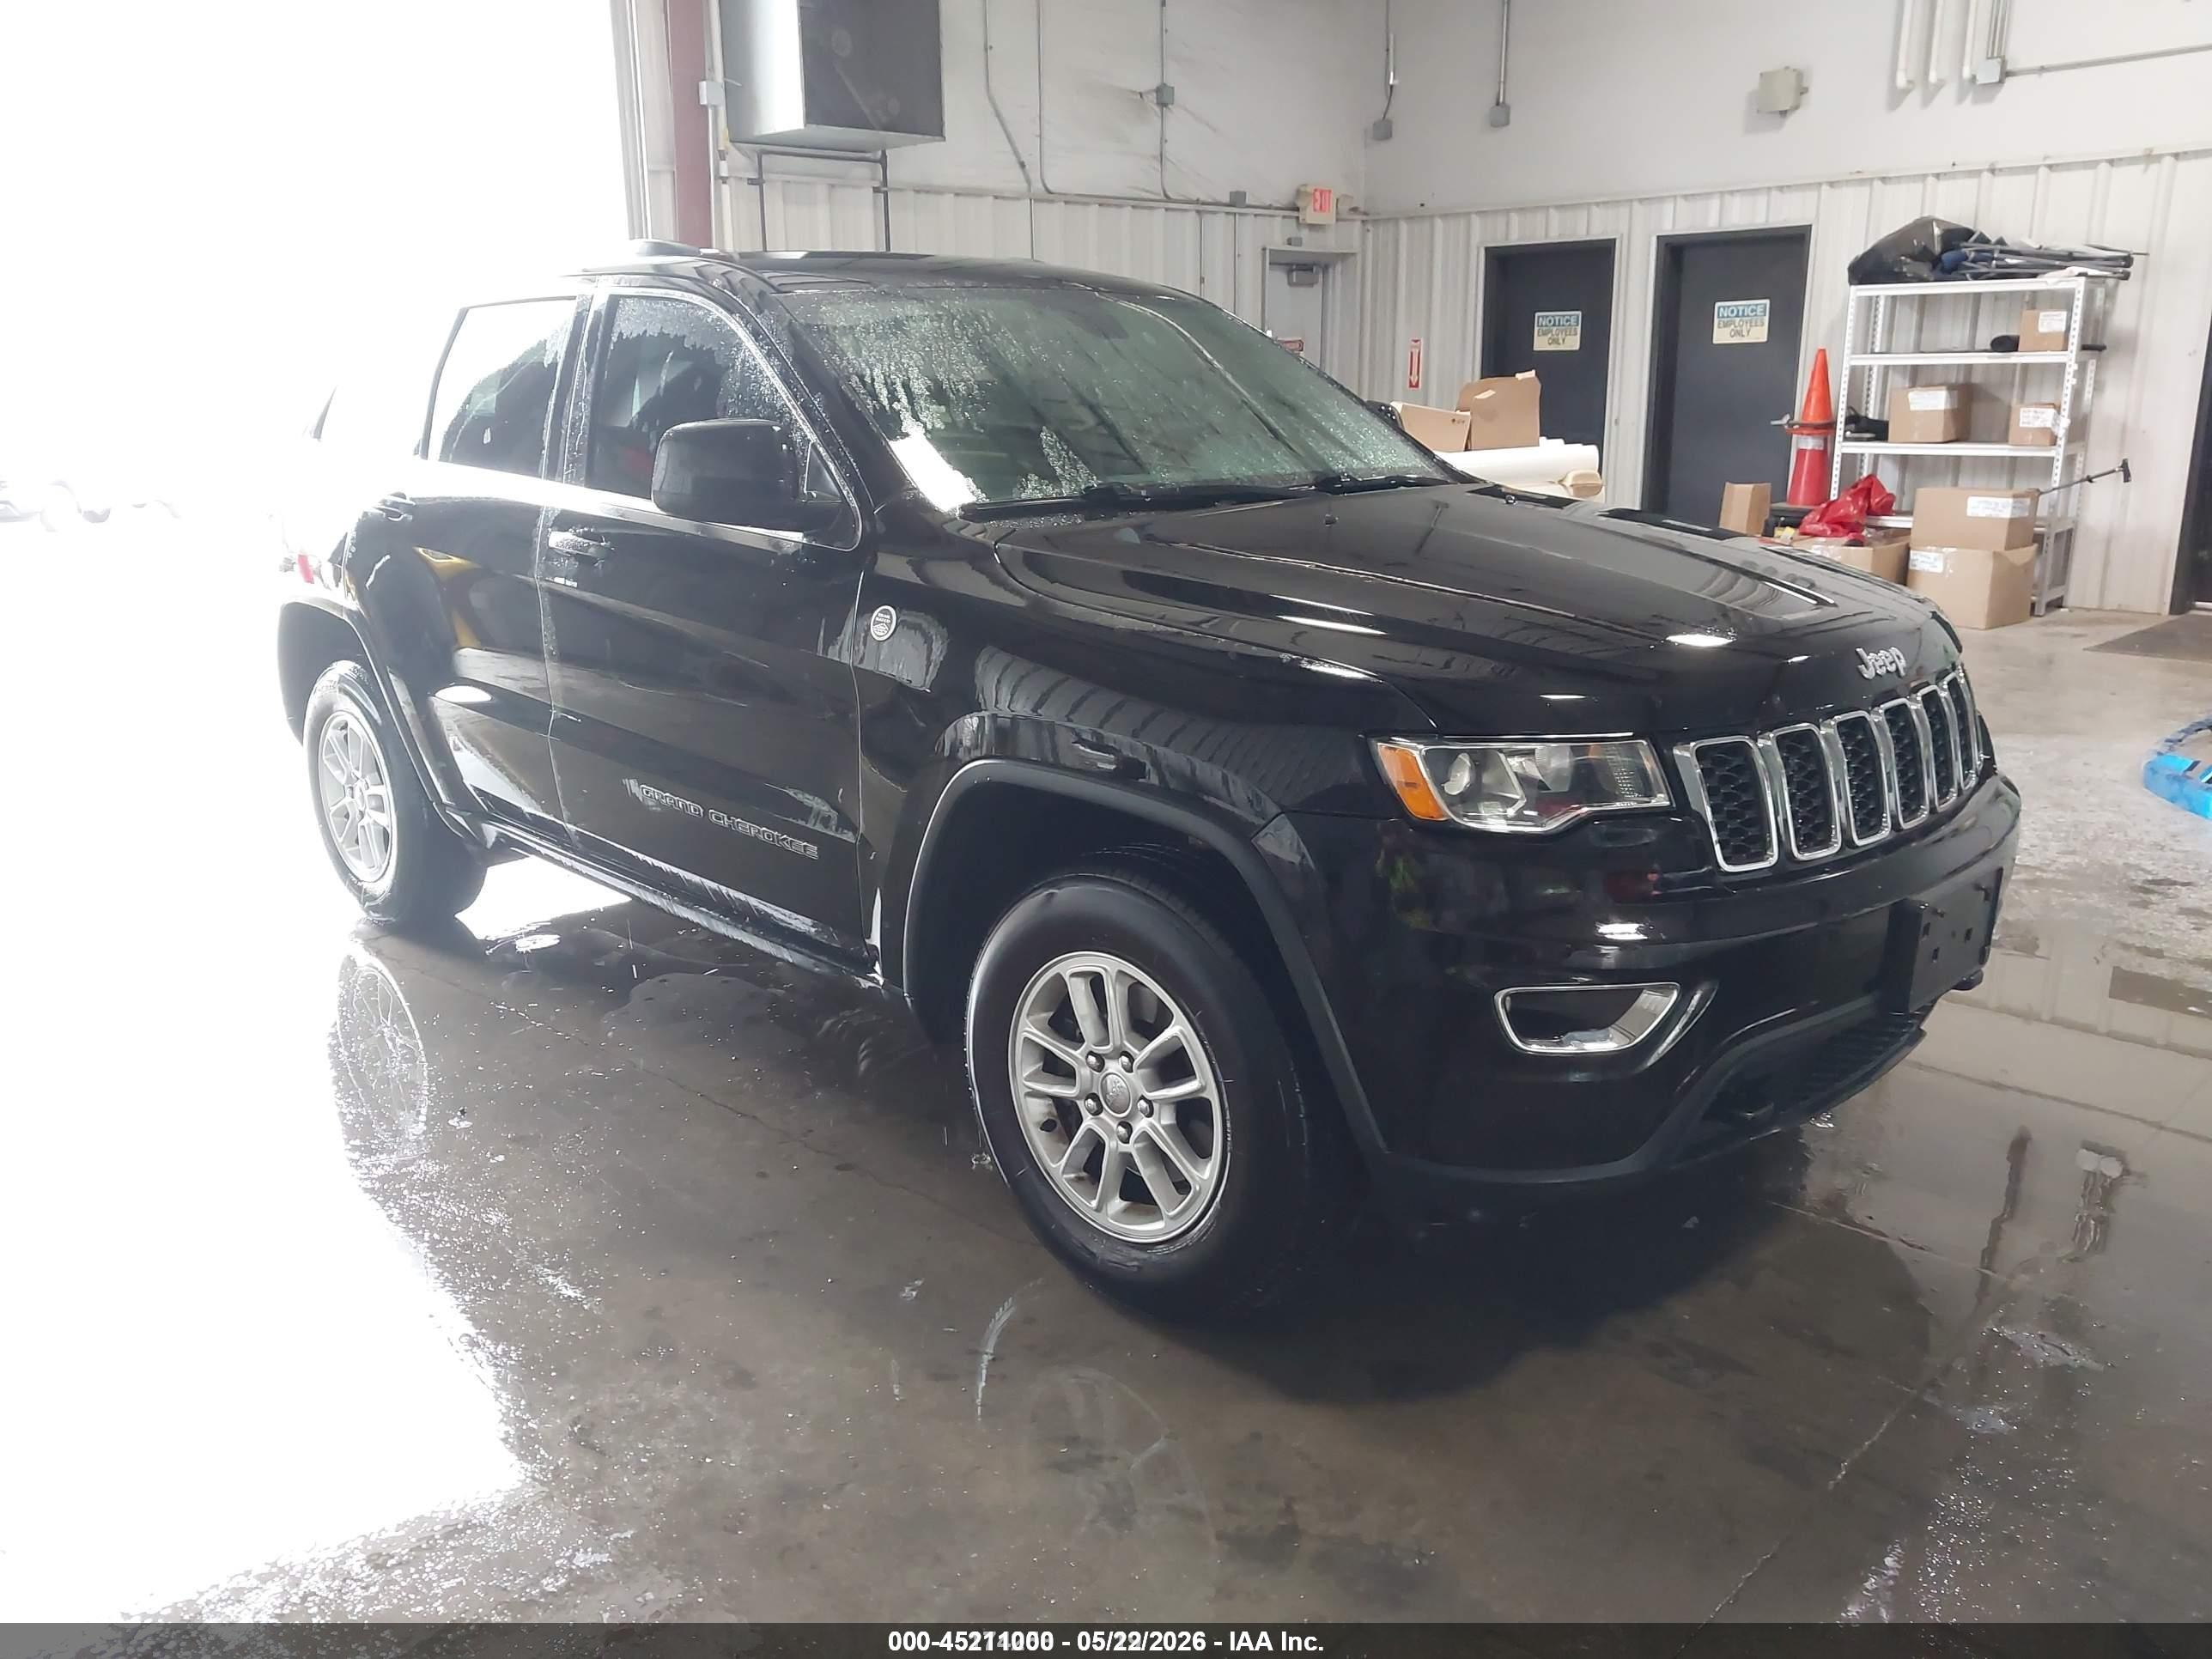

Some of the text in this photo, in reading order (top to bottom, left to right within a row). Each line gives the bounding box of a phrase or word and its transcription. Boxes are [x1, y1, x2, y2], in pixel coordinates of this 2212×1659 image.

[1719, 304, 1765, 317] NOTICE
[1538, 316, 1577, 326] NOTICE
[1717, 319, 1765, 329] EMPLOYEES
[1729, 328, 1751, 337] ONLY
[1547, 337, 1566, 346] ONLY
[1855, 647, 1907, 680] Jeep
[640, 784, 818, 860] GRAND CHEROKEE
